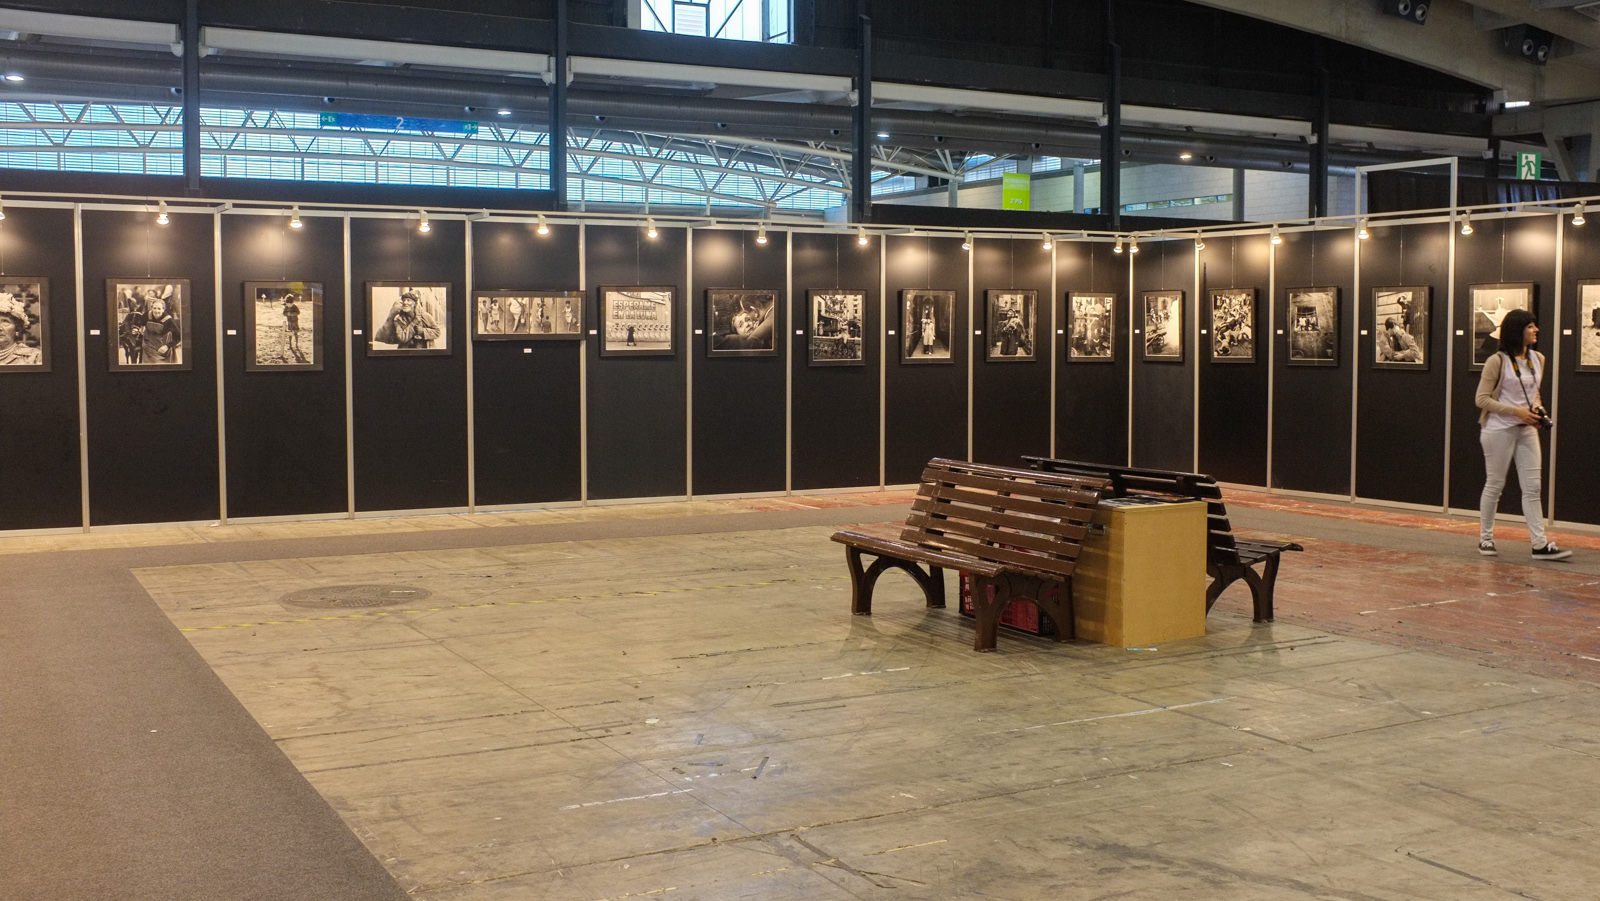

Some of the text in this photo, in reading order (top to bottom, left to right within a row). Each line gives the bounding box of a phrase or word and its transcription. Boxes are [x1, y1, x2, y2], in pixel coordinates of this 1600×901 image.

[396, 117, 404, 129] 2
[613, 300, 656, 310] ESPERAME
[613, 310, 657, 320] EN LA LUNA
